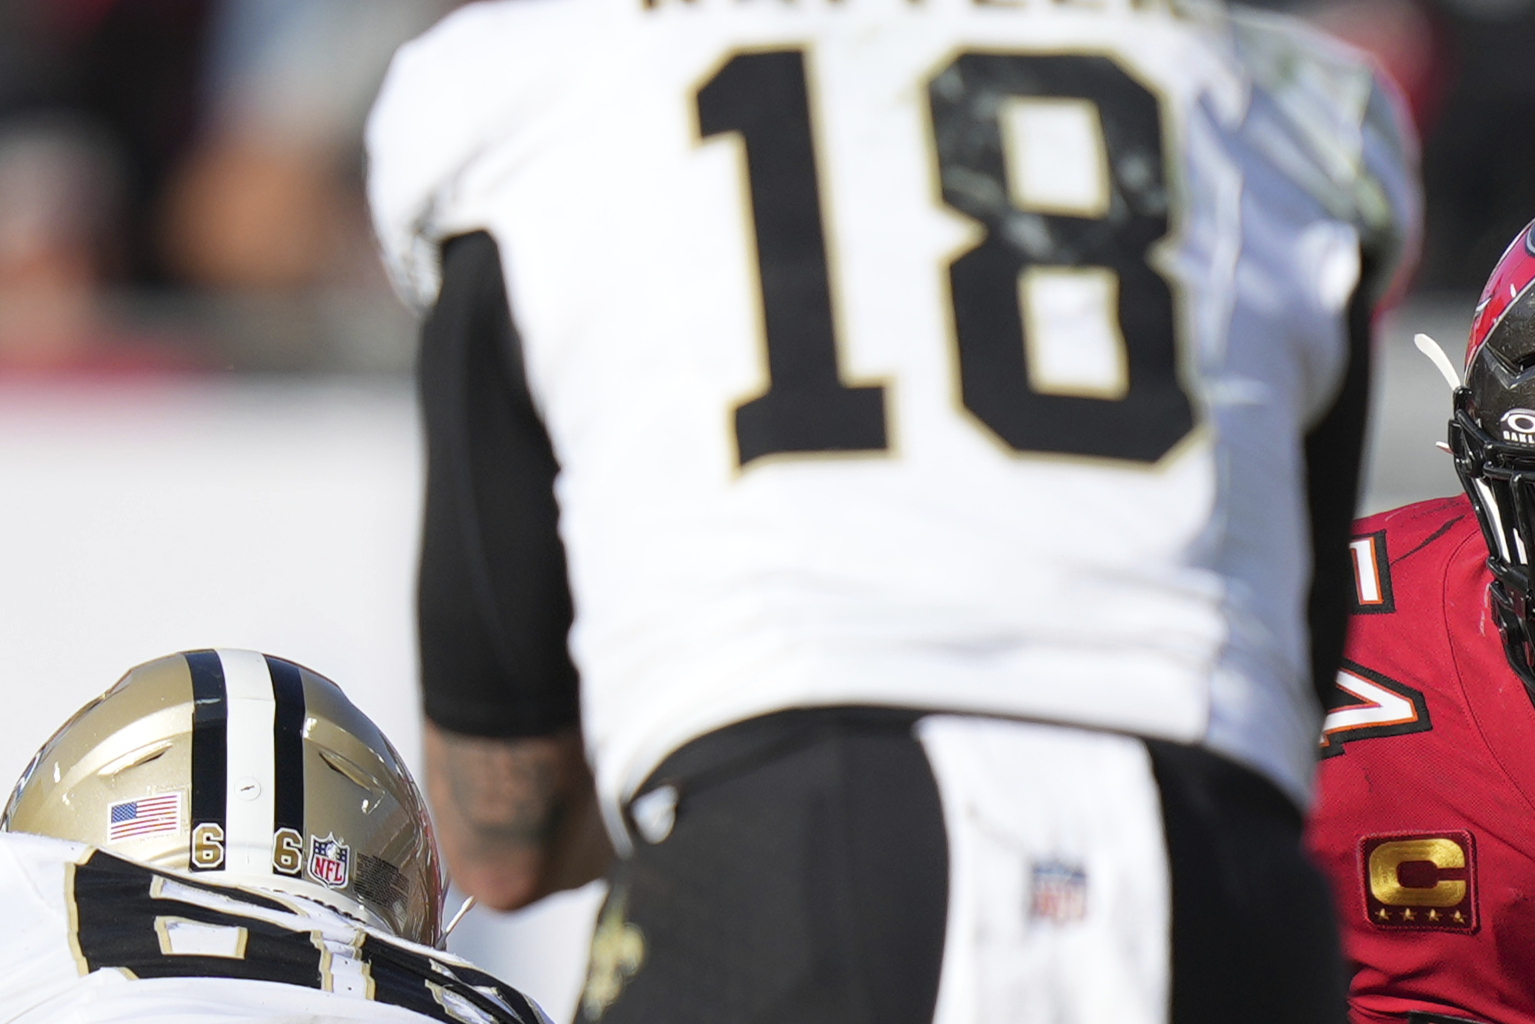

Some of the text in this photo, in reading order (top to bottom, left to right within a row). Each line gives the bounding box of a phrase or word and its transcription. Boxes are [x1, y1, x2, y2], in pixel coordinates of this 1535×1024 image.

[690, 43, 1208, 472] 18
[315, 856, 343, 883] NFL
[1369, 838, 1467, 908] C
